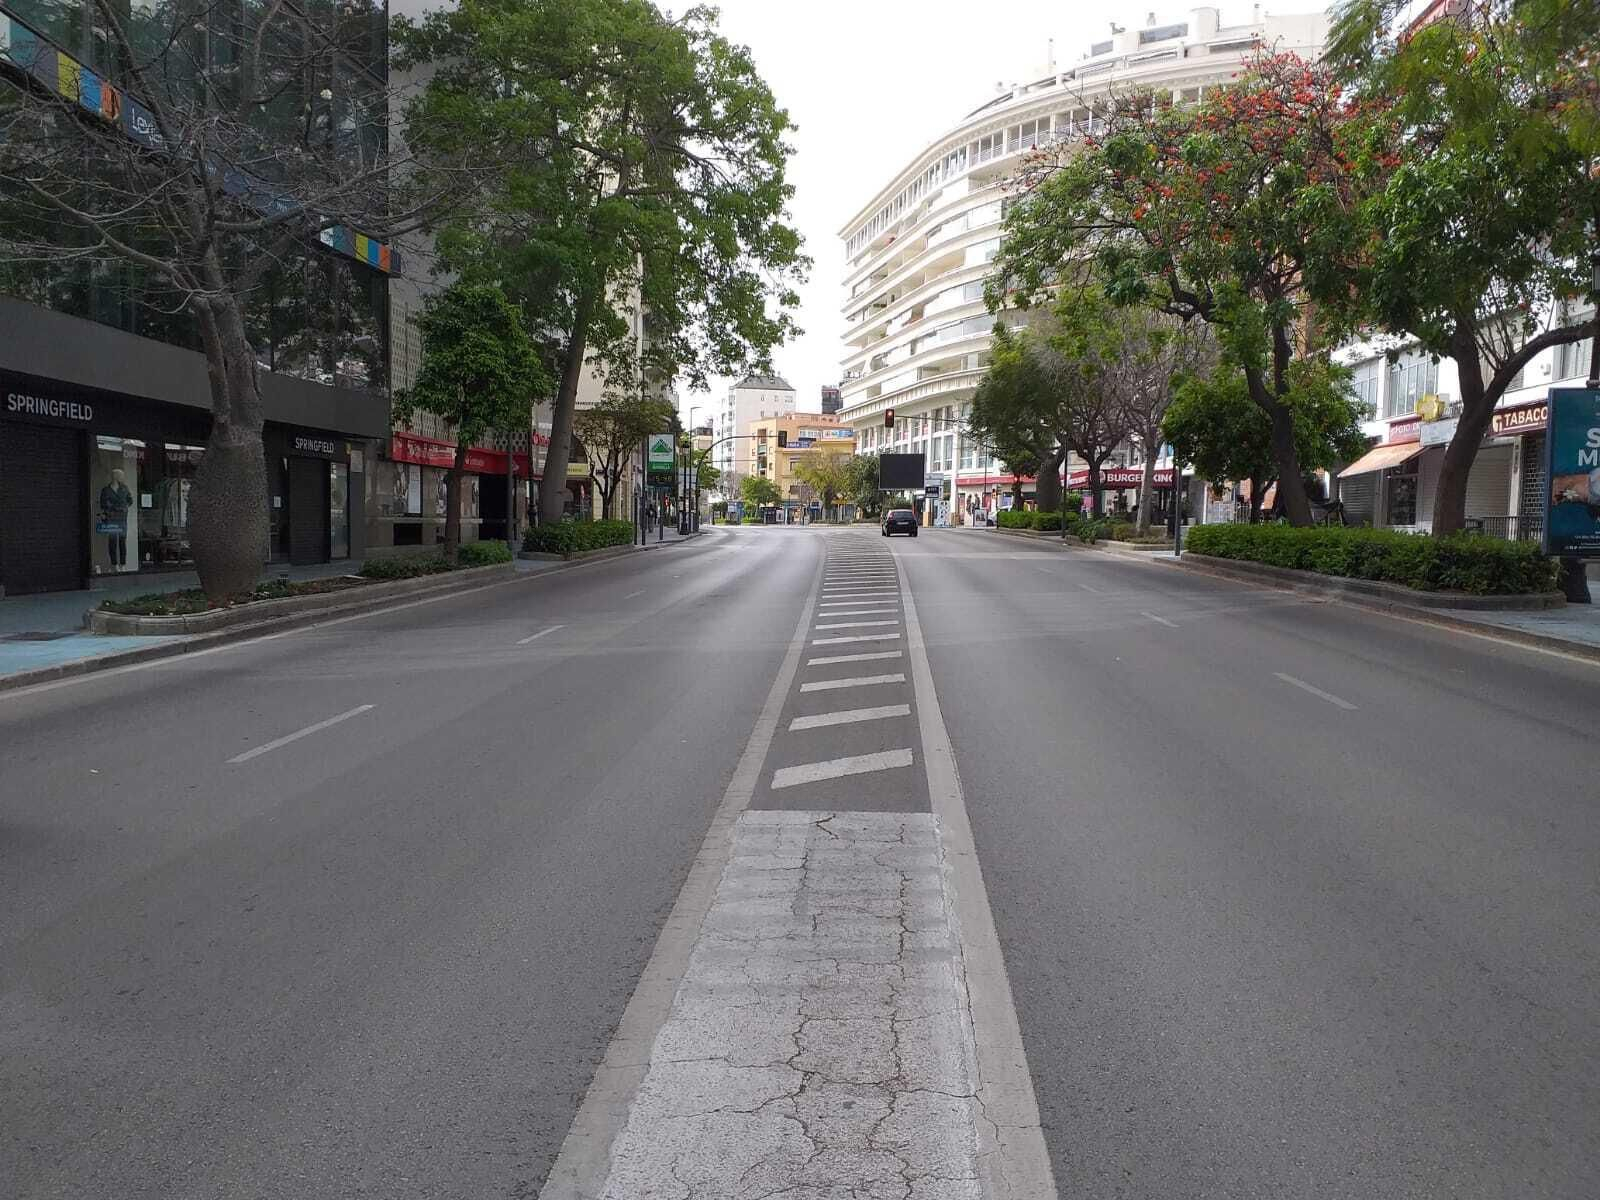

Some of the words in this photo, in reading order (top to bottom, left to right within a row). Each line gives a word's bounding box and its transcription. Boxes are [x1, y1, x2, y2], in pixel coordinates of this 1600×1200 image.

[7, 393, 93, 421] SPRINGFIELD
[295, 437, 334, 454] SPRINGFIELD
[1107, 473, 1145, 483] BURGE
